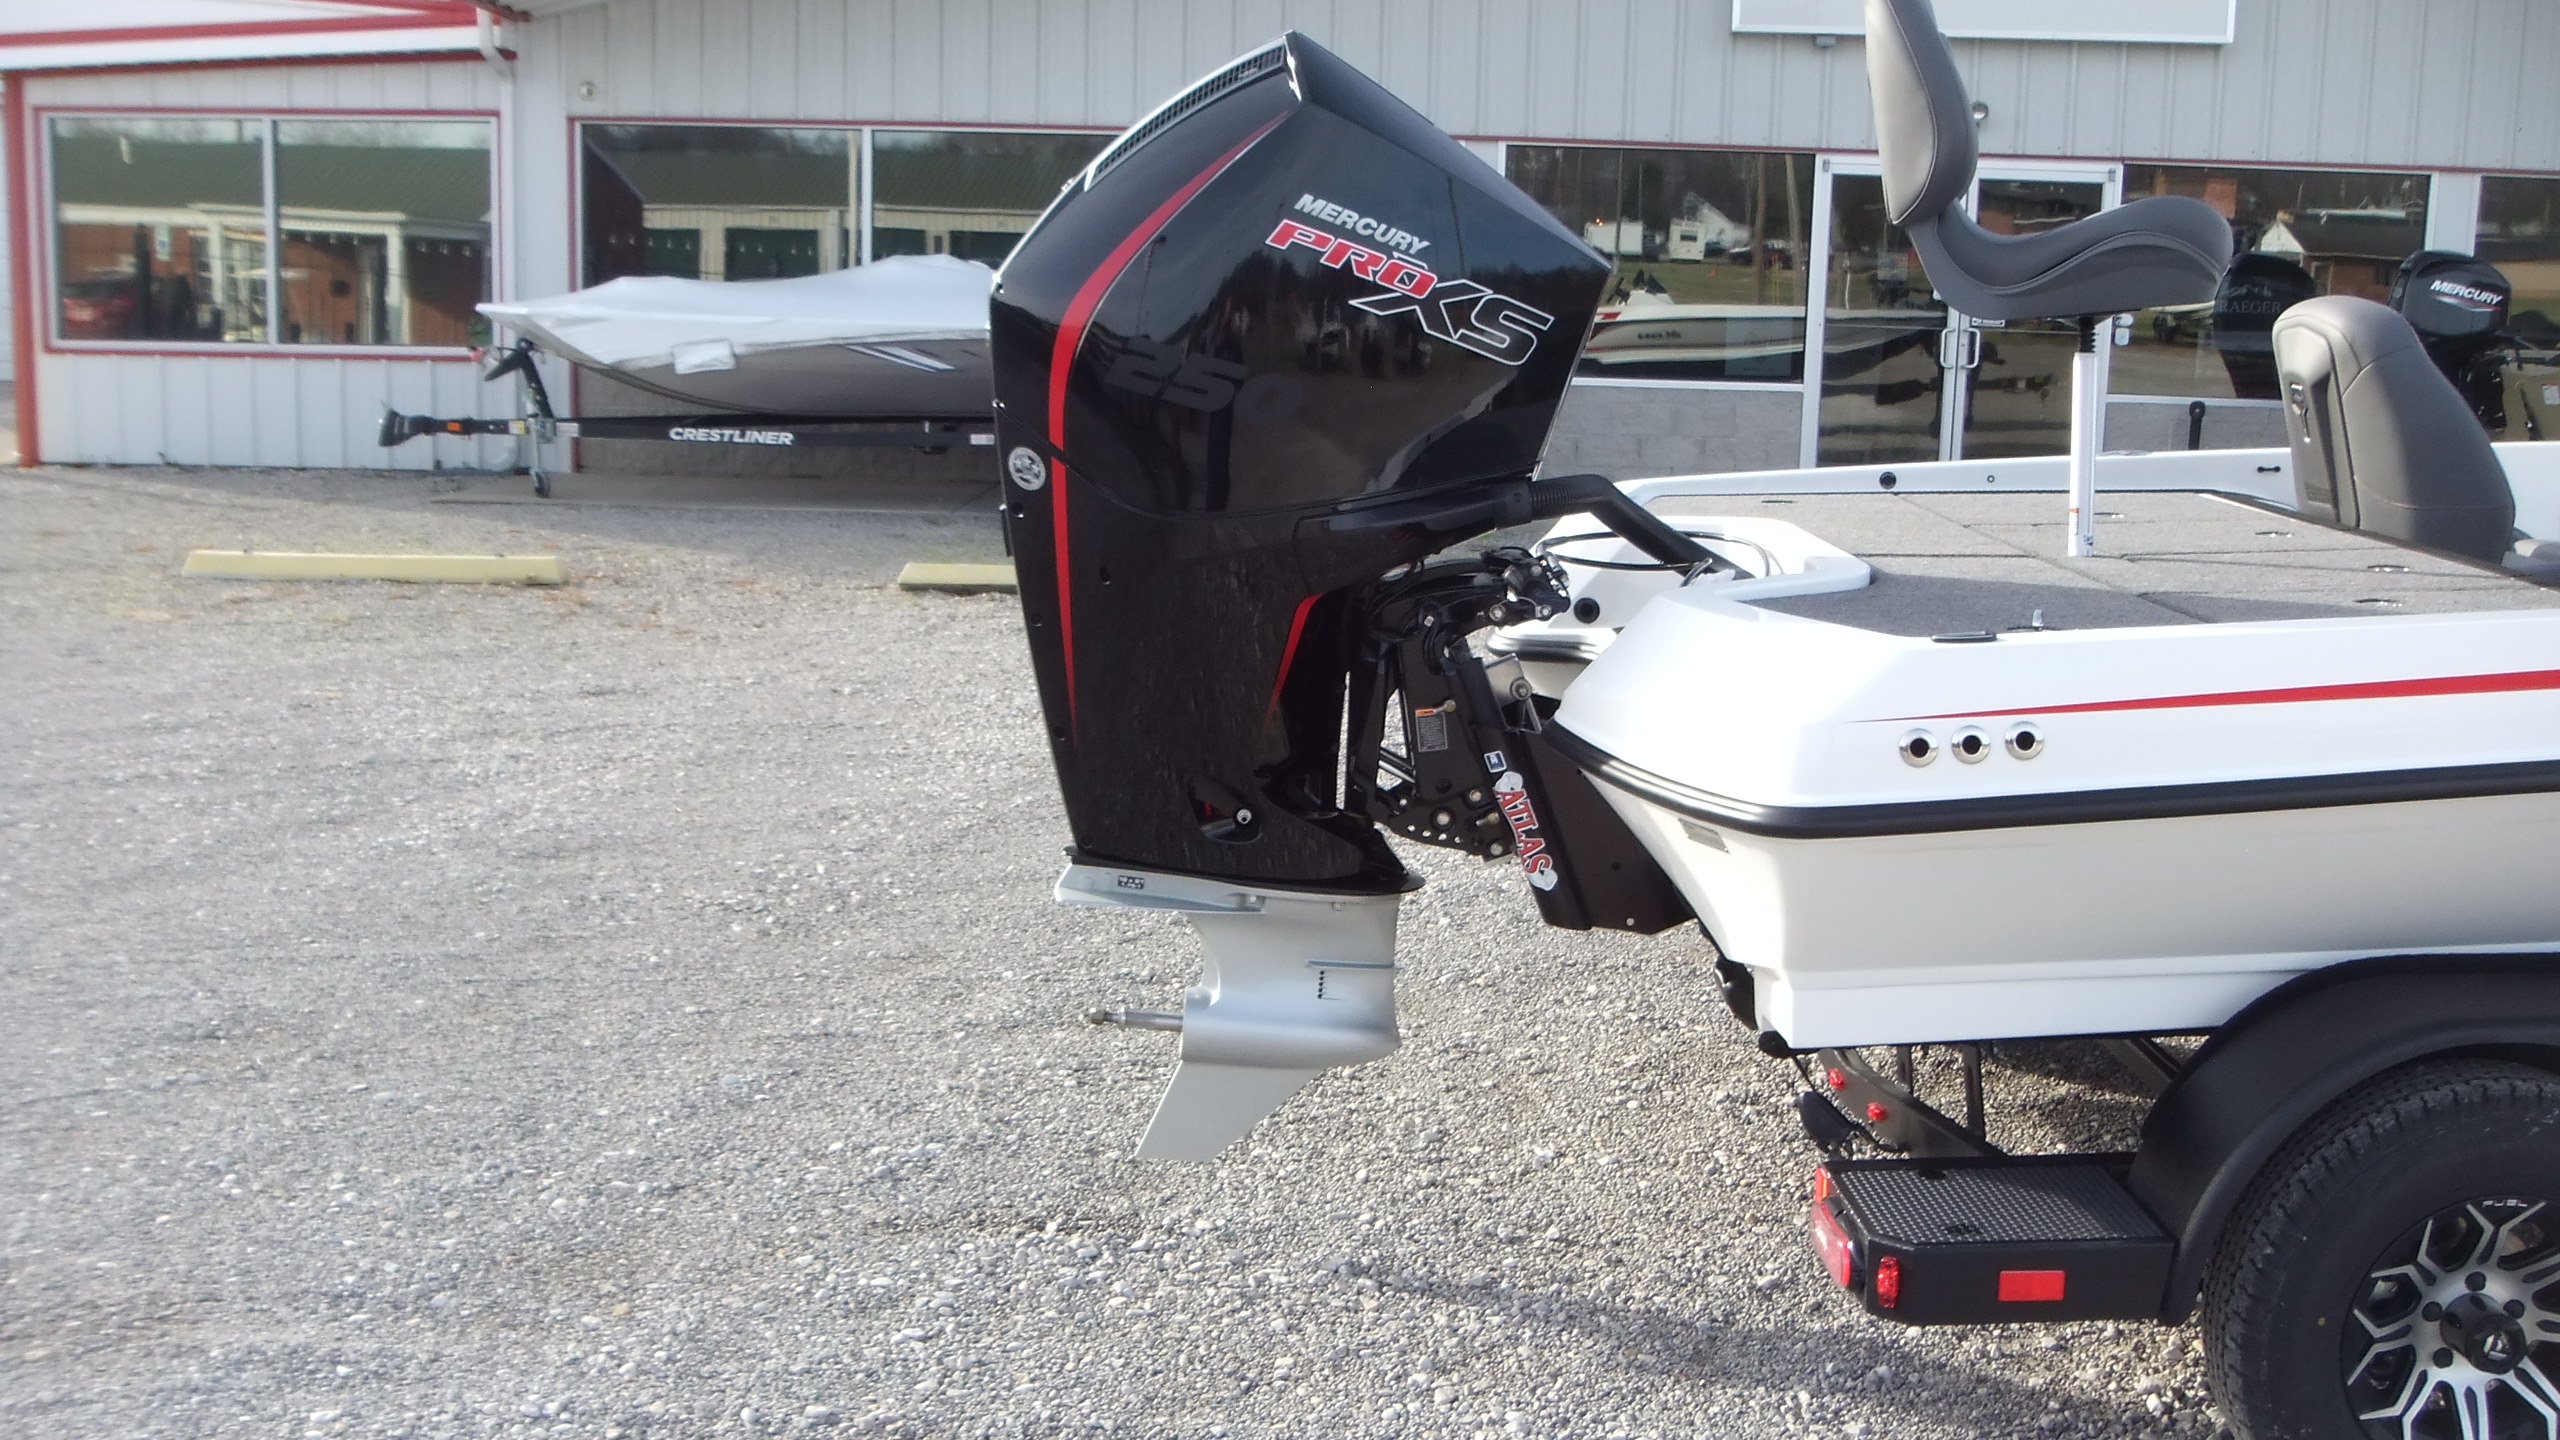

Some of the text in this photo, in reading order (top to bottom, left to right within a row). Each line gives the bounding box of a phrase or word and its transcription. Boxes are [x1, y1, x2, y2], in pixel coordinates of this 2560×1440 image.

[1294, 194, 1431, 255] MERCURY
[1265, 218, 1555, 367] PRO XS
[2430, 279, 2503, 305] MERCURY
[2215, 300, 2282, 313] RAEGER
[669, 426, 794, 445] CRESTLINER
[1493, 788, 1553, 874] ATLAS
[2482, 1199, 2528, 1207] FUEL
